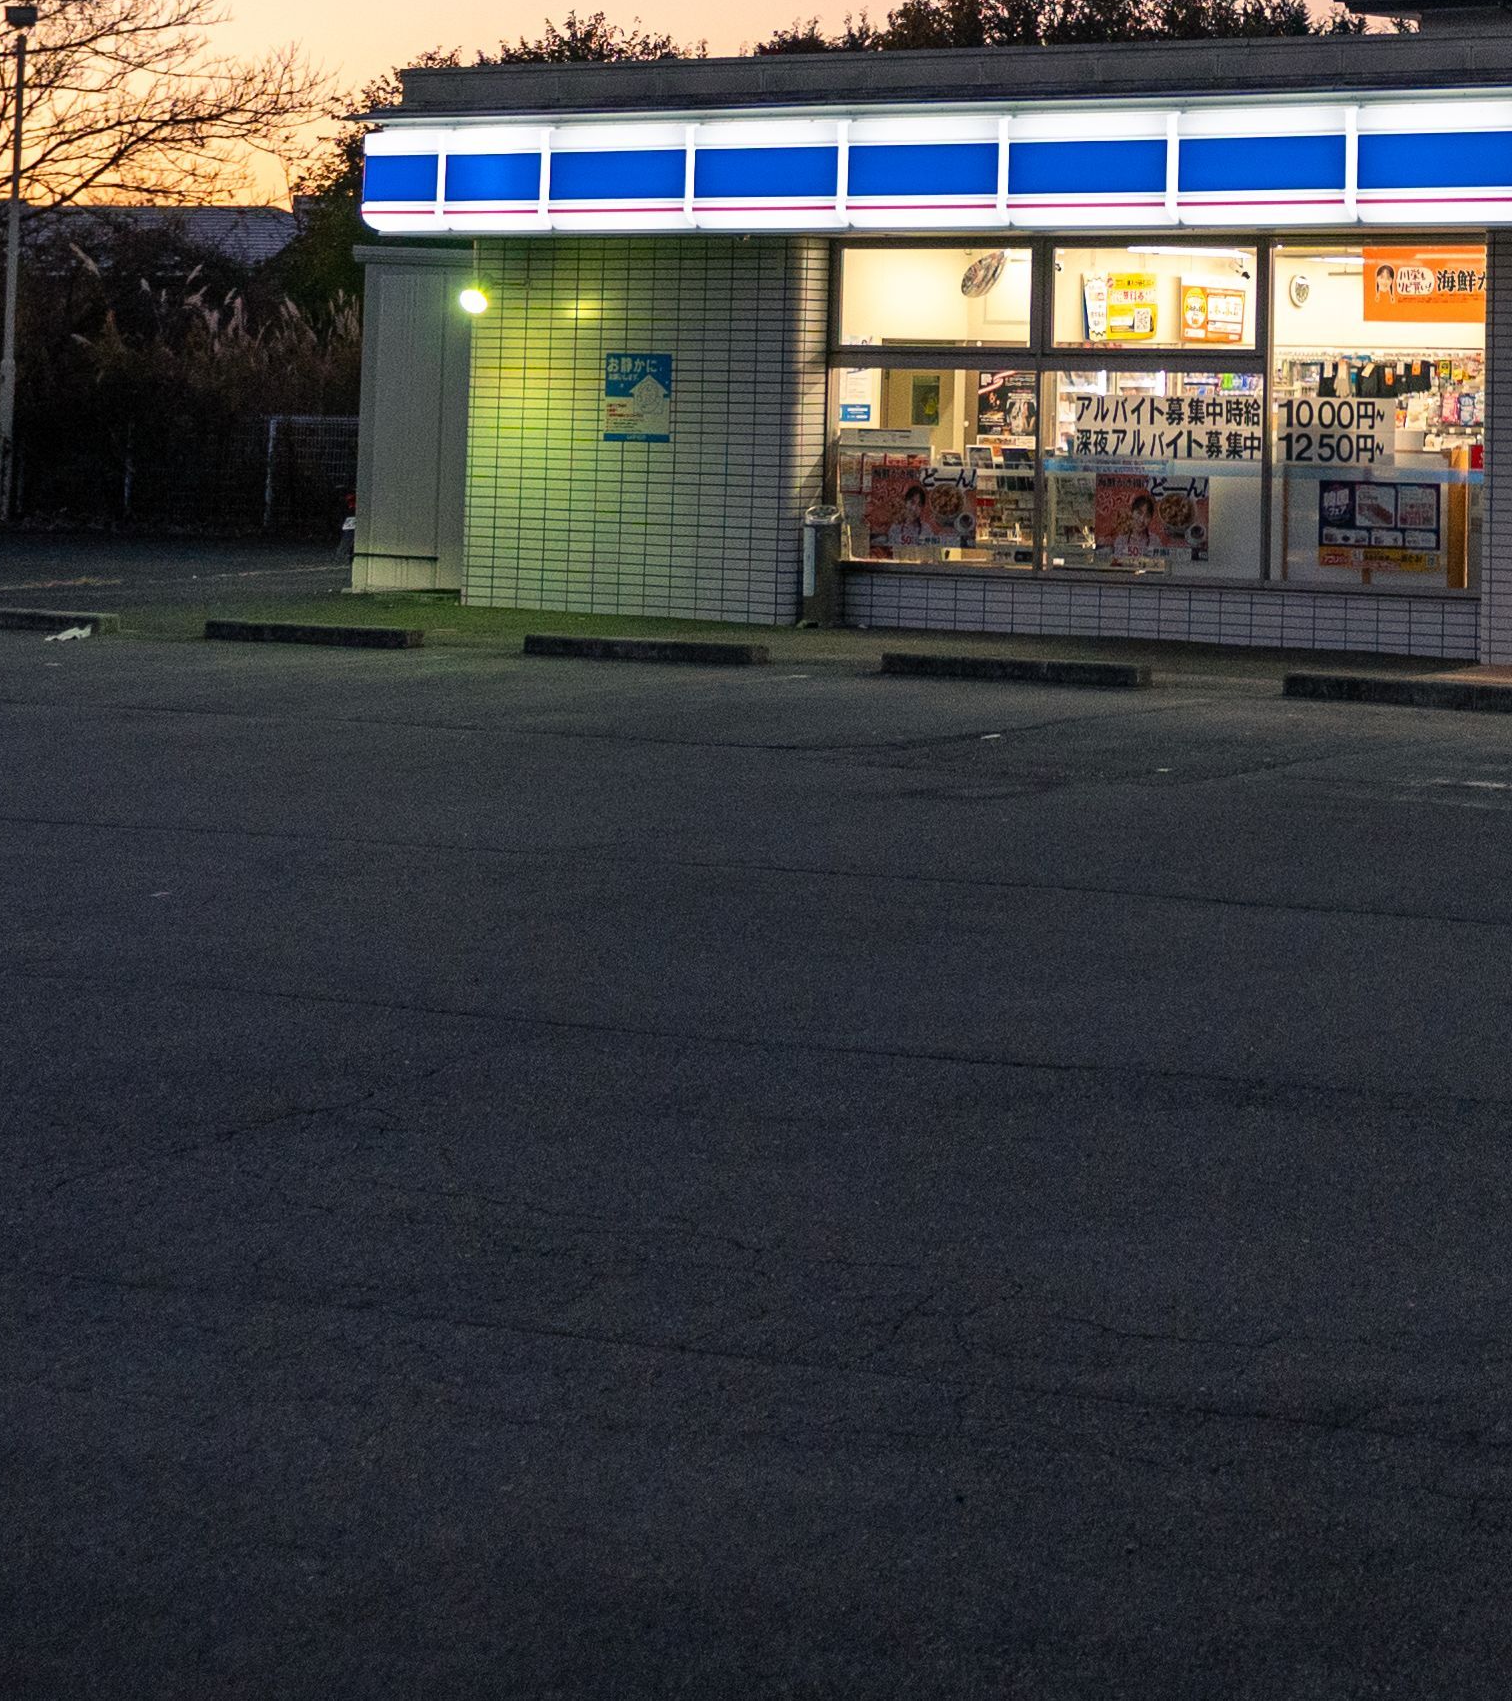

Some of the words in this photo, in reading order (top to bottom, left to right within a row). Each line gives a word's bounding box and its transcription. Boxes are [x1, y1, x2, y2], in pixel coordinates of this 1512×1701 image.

[1076, 396, 1262, 427] アルバイト募集中時給
[1076, 428, 1262, 460] 深夜アルバイト募集中
